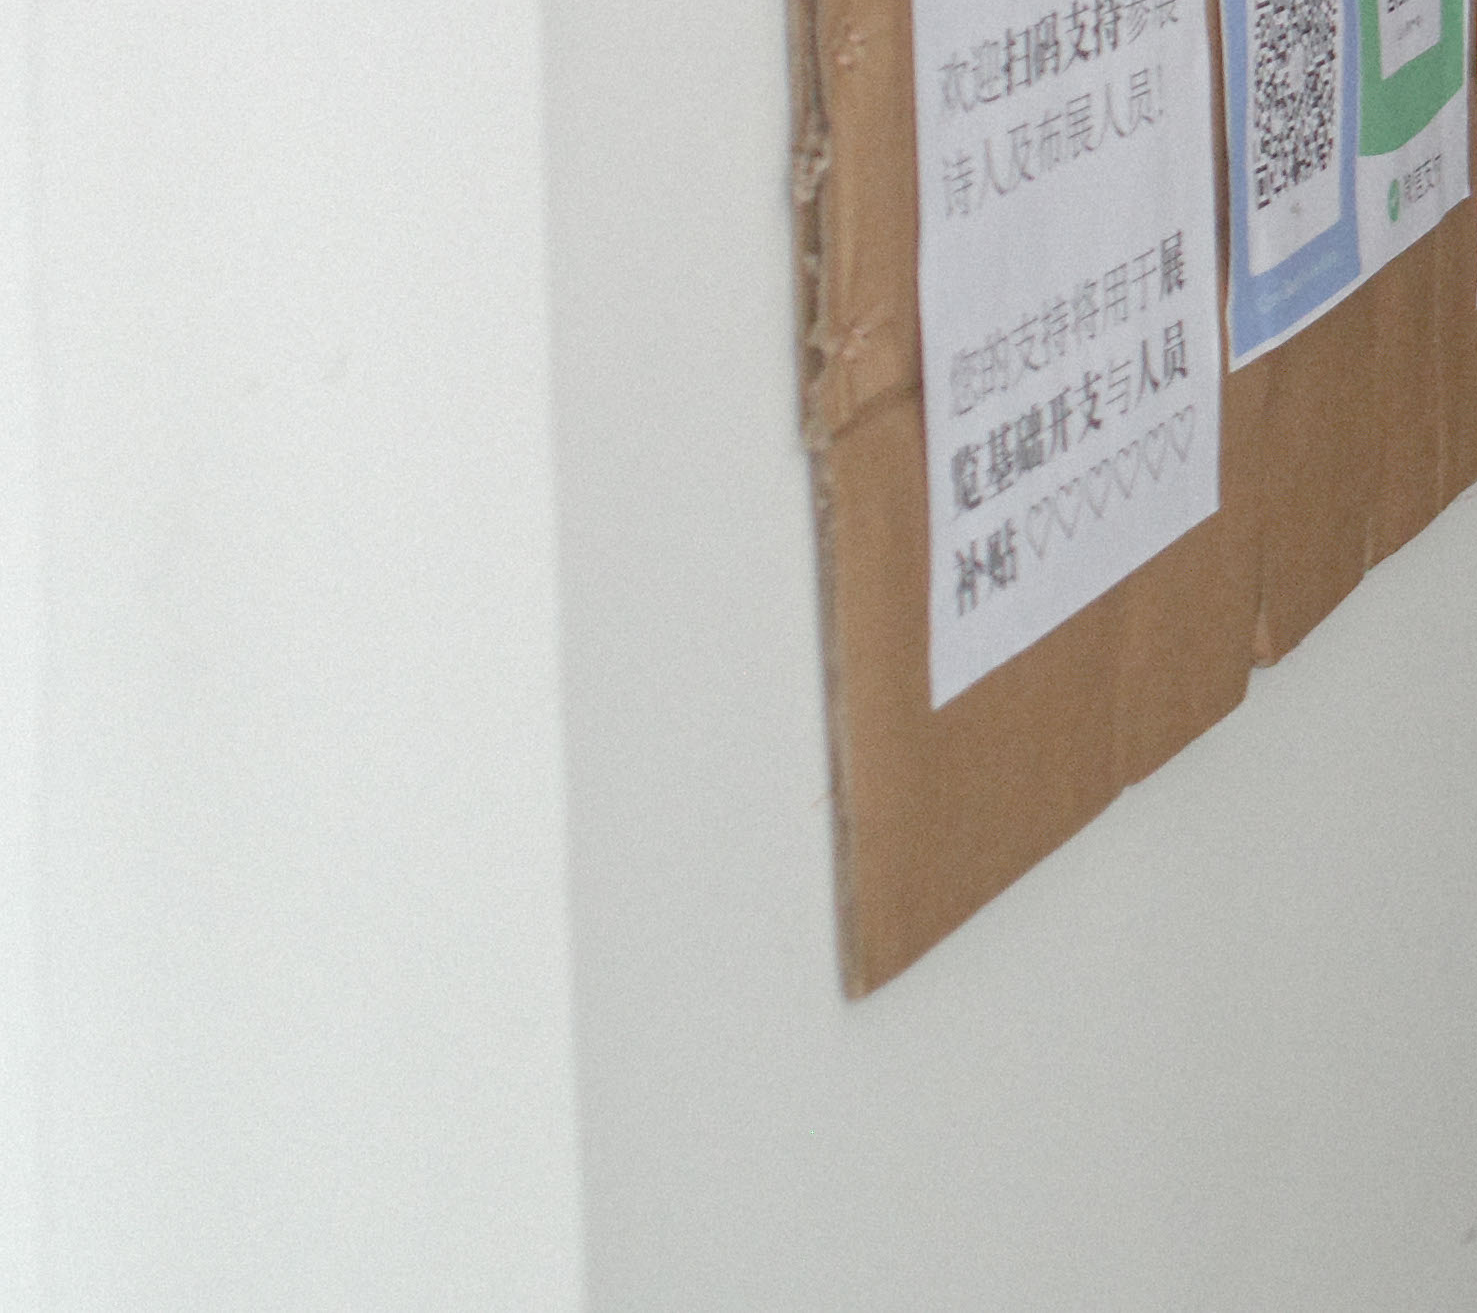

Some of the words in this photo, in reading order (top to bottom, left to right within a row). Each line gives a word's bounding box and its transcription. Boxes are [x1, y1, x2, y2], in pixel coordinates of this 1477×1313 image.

[948, 230, 1186, 416] 您的支持将用于展
[950, 319, 1190, 517] 览基础开支与人员
